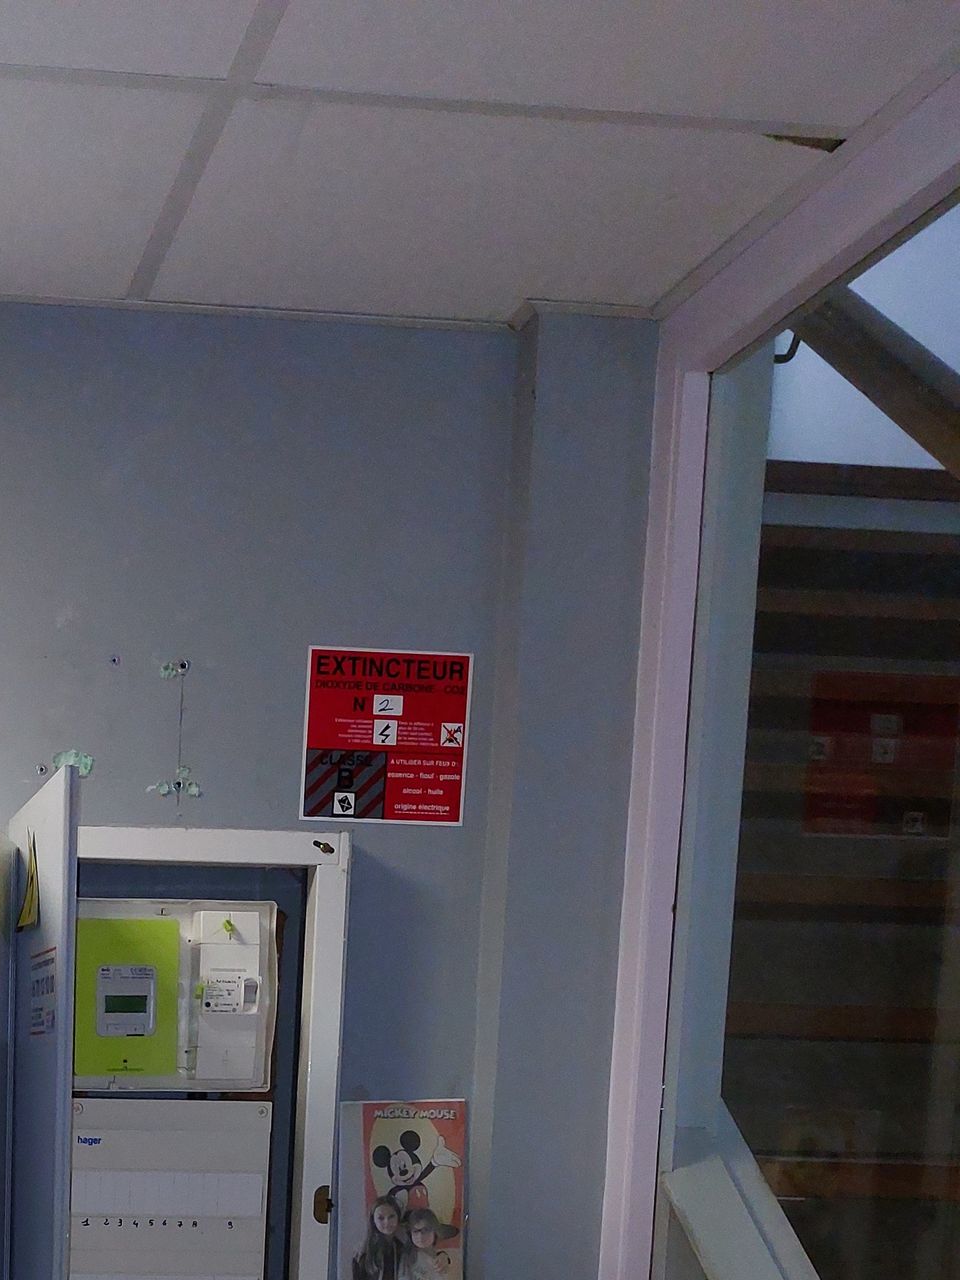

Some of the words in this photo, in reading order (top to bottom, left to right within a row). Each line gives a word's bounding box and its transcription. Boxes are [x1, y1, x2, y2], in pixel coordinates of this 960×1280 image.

[316, 655, 465, 681] EXTINCTEUR
[315, 680, 363, 691] DIOXYDE
[365, 682, 380, 692] DE
[382, 682, 435, 694] CARBONE
[377, 698, 395, 713] 2
[337, 768, 354, 790] B
[394, 803, 417, 812] origine
[374, 1109, 416, 1120] MICKEY
[418, 1108, 457, 1121] MOUSE
[77, 1135, 102, 1146] hager
